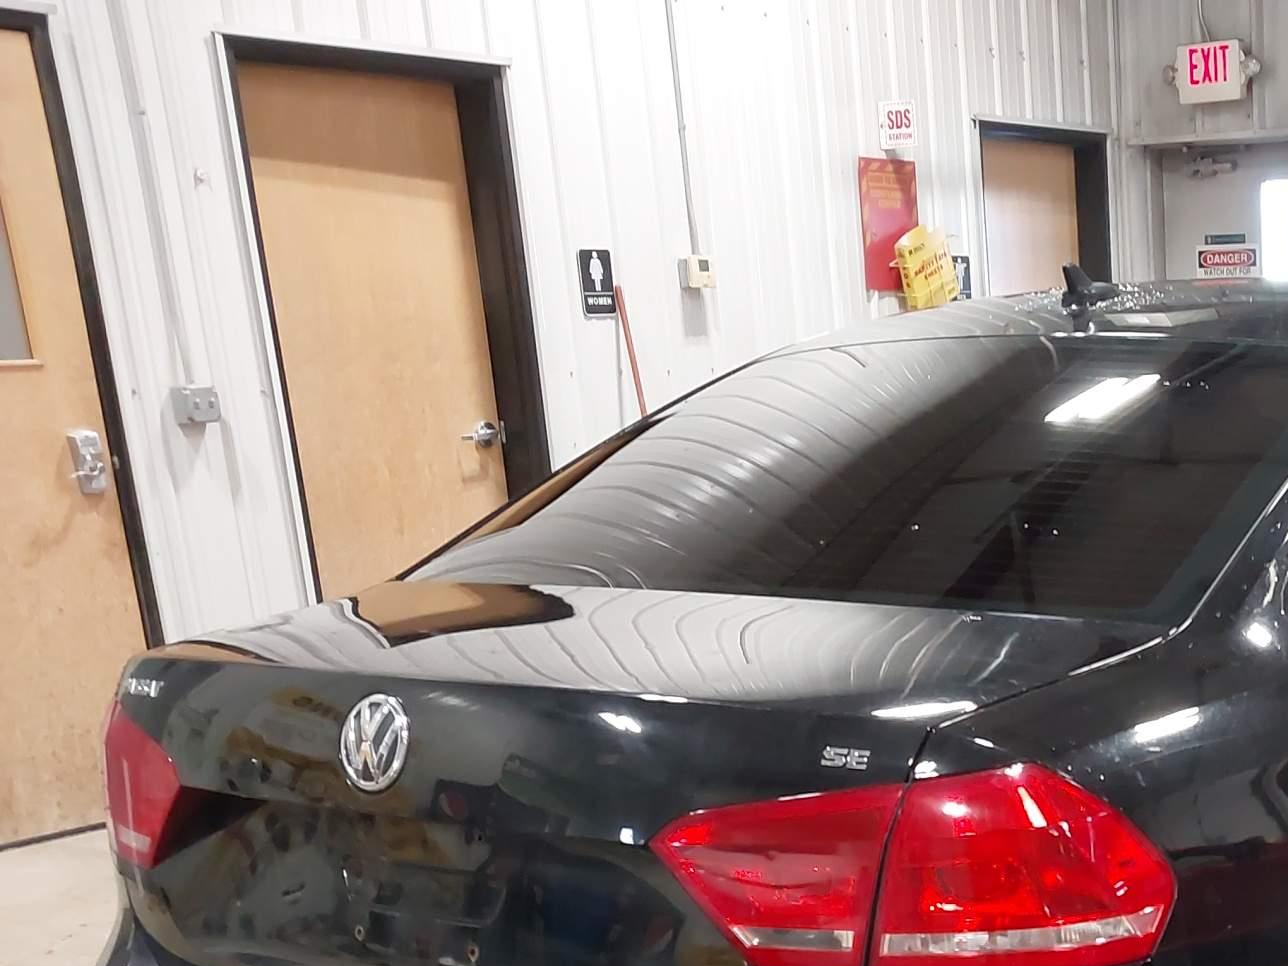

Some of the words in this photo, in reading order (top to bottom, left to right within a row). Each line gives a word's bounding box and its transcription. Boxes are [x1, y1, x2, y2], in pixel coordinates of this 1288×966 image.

[1188, 45, 1229, 85] EXIT
[887, 108, 911, 130] SDS
[1206, 253, 1248, 264] DANGER
[1203, 267, 1225, 277] WATCH
[1226, 267, 1238, 276] OUT
[587, 296, 612, 306] WOMEN
[820, 745, 871, 771] SE
